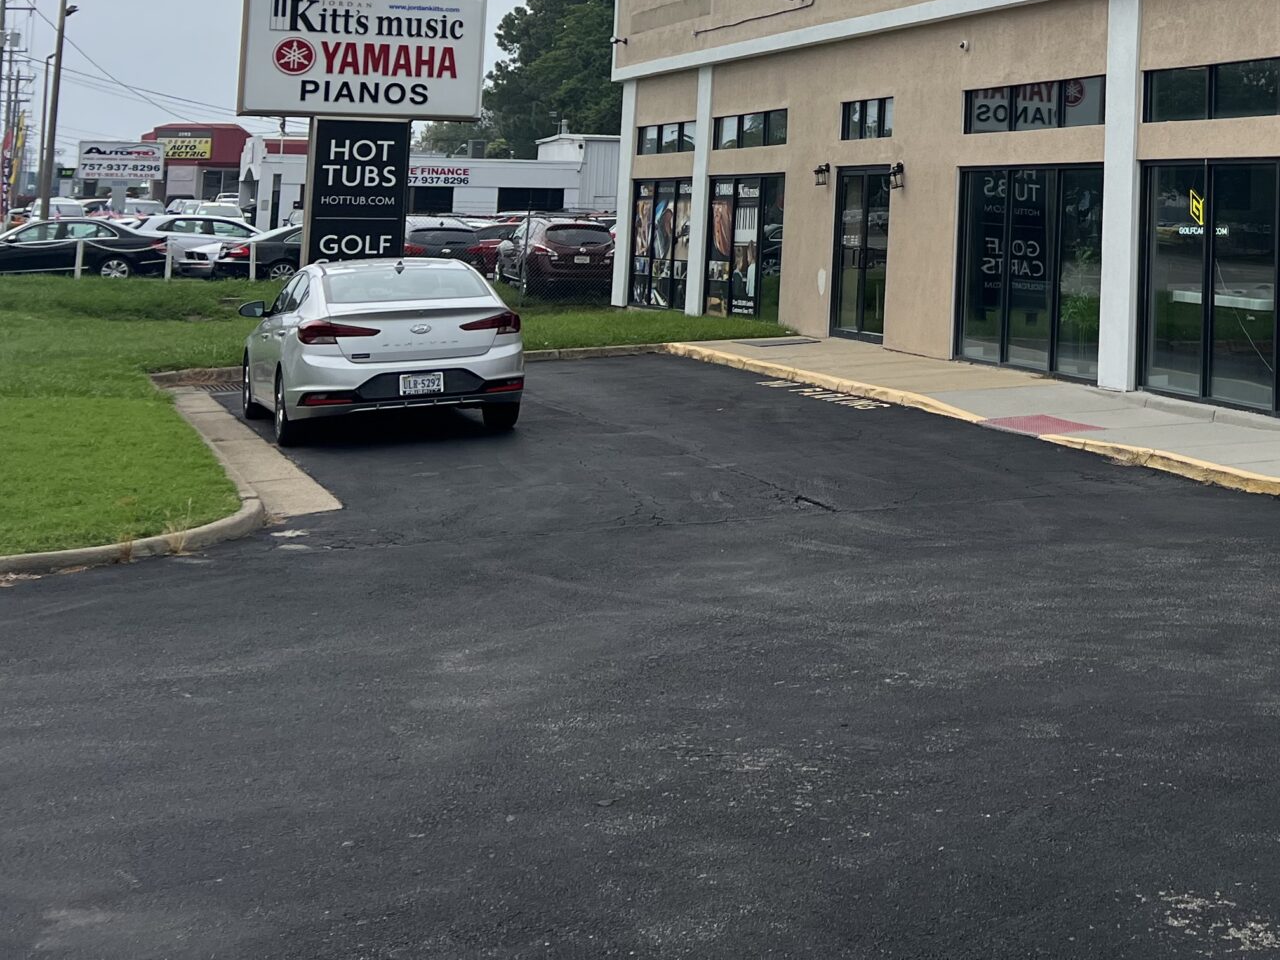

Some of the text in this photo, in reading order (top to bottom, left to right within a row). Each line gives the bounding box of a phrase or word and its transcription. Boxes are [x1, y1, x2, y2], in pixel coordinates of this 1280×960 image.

[322, 0, 373, 9] JORDAN
[388, 3, 461, 13] www.jordankitts.com
[375, 14, 464, 40] music
[320, 41, 458, 79] YAMAHA
[300, 80, 429, 106] PIANOS
[329, 139, 395, 162] HOT
[81, 163, 161, 172] 757-937-8296
[322, 165, 397, 187] TUBS
[420, 167, 470, 176] FINANCE
[320, 195, 395, 206] HOTTUB.COM
[319, 234, 392, 255] GOLF
